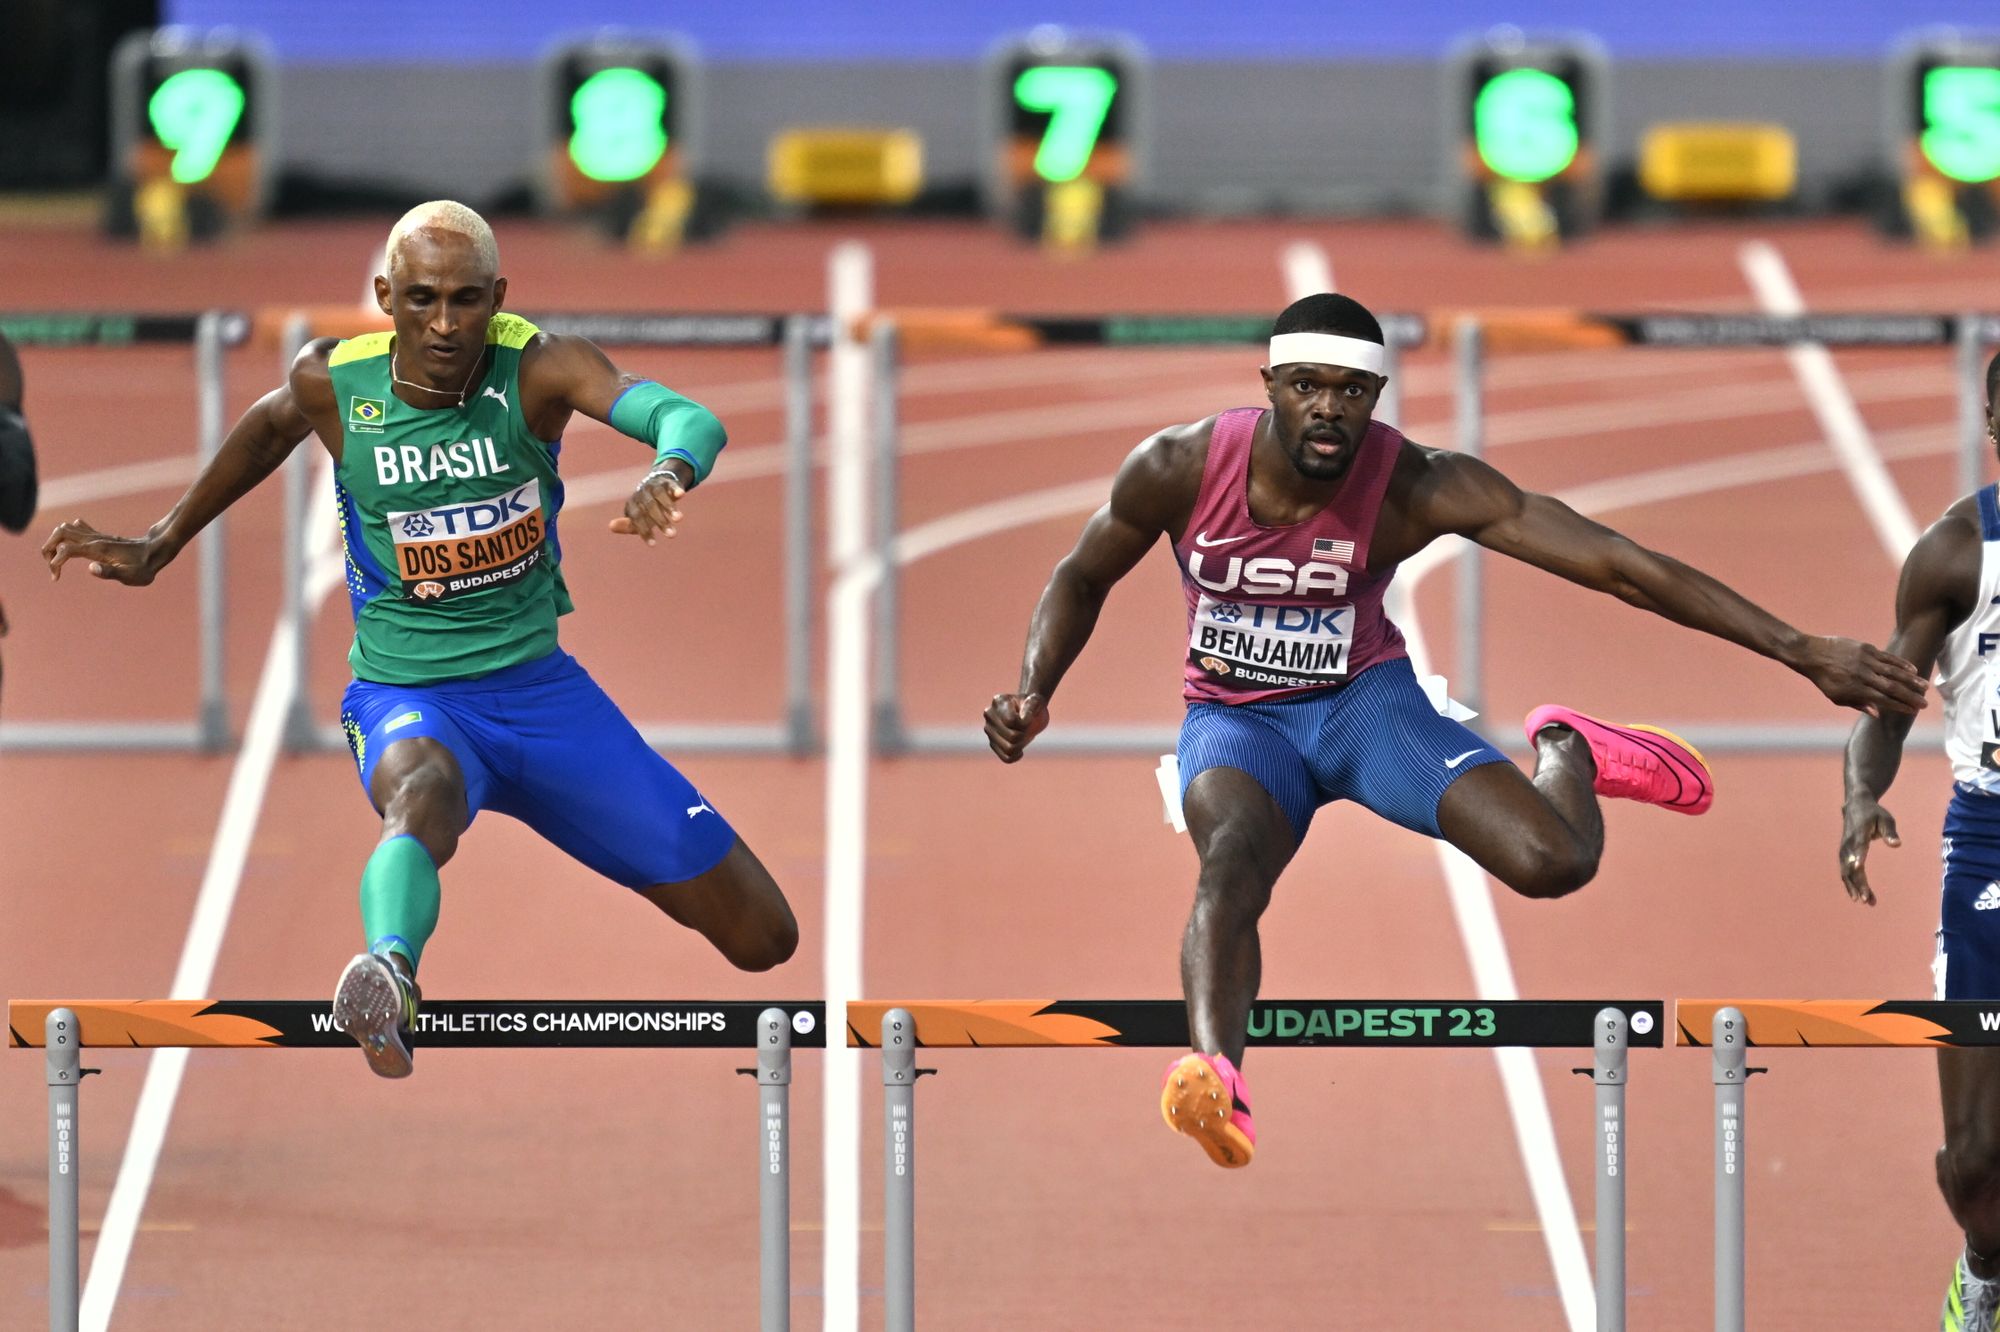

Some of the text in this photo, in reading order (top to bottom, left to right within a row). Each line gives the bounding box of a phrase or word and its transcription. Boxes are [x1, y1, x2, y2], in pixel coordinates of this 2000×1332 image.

[149, 69, 243, 183] 9
[569, 68, 666, 181] 8
[1015, 67, 1116, 182] 7
[1476, 68, 1578, 182] 6
[1922, 67, 2000, 182] 5
[374, 437, 509, 486] BRASIL
[431, 487, 530, 535] TDK
[403, 515, 540, 576] DOS SANTOS
[1188, 550, 1349, 596] USA
[450, 561, 527, 591] BUDAPEST
[1245, 604, 1346, 635] TDK
[1200, 625, 1342, 670] BENJAMIN
[415, 1011, 726, 1032] THLETICS CHAMPIONSHIPS
[1247, 1008, 1496, 1037] UDAPEST 23
[57, 1119, 70, 1175] MONDO
[767, 1118, 781, 1174] MONDO
[893, 1121, 907, 1176] MONDO
[1604, 1121, 1618, 1177] MONDO
[1723, 1119, 1737, 1174] MONDO
